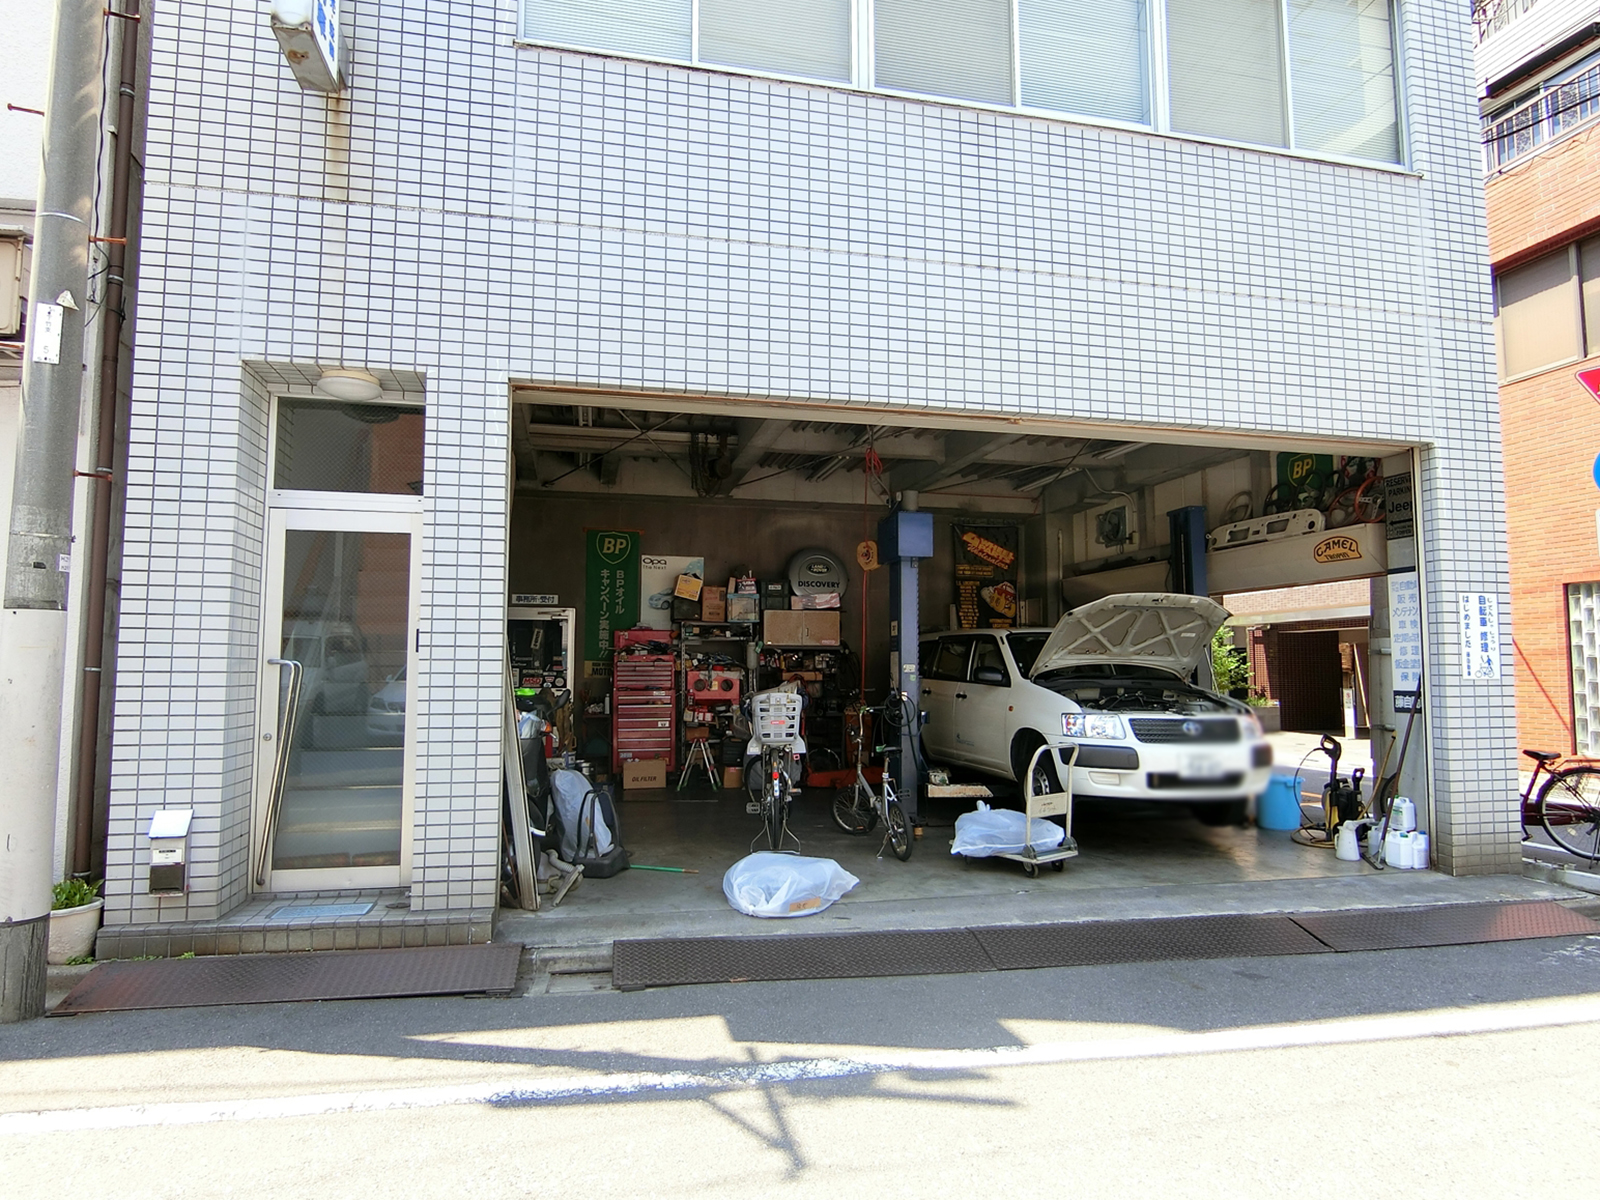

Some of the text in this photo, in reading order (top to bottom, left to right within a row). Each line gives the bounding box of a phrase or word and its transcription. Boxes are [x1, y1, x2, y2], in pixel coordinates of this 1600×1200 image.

[1292, 458, 1313, 480] BP
[1388, 500, 1413, 514] Jee
[602, 537, 627, 554] BP
[1315, 539, 1356, 557] CAMEL
[642, 557, 667, 566] Opa
[615, 570, 625, 615] BPオイル
[797, 580, 840, 589] DISCOVERY
[1478, 595, 1487, 627] 自転車
[1462, 595, 1472, 649] はじめました
